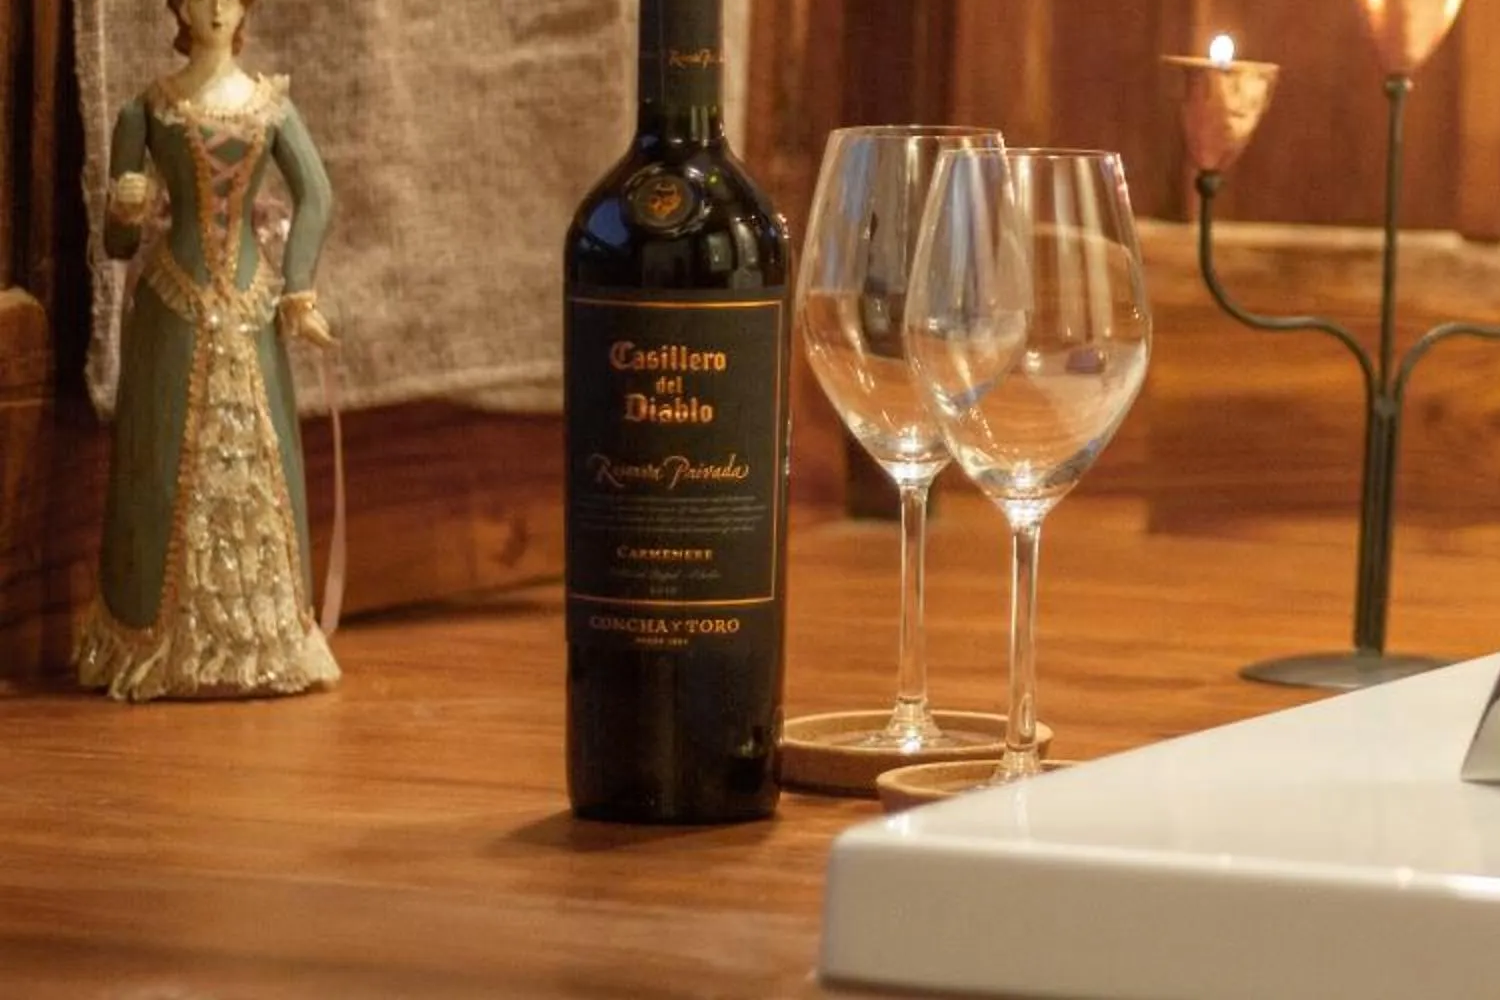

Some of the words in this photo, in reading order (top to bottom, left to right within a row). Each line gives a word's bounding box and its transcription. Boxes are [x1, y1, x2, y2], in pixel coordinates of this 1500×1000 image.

[609, 340, 728, 371] Casillero
[655, 376, 684, 394] del
[624, 393, 714, 423] Diablo
[663, 453, 750, 490] Privada
[589, 614, 669, 634] CONCHA
[685, 617, 741, 634] TORO
